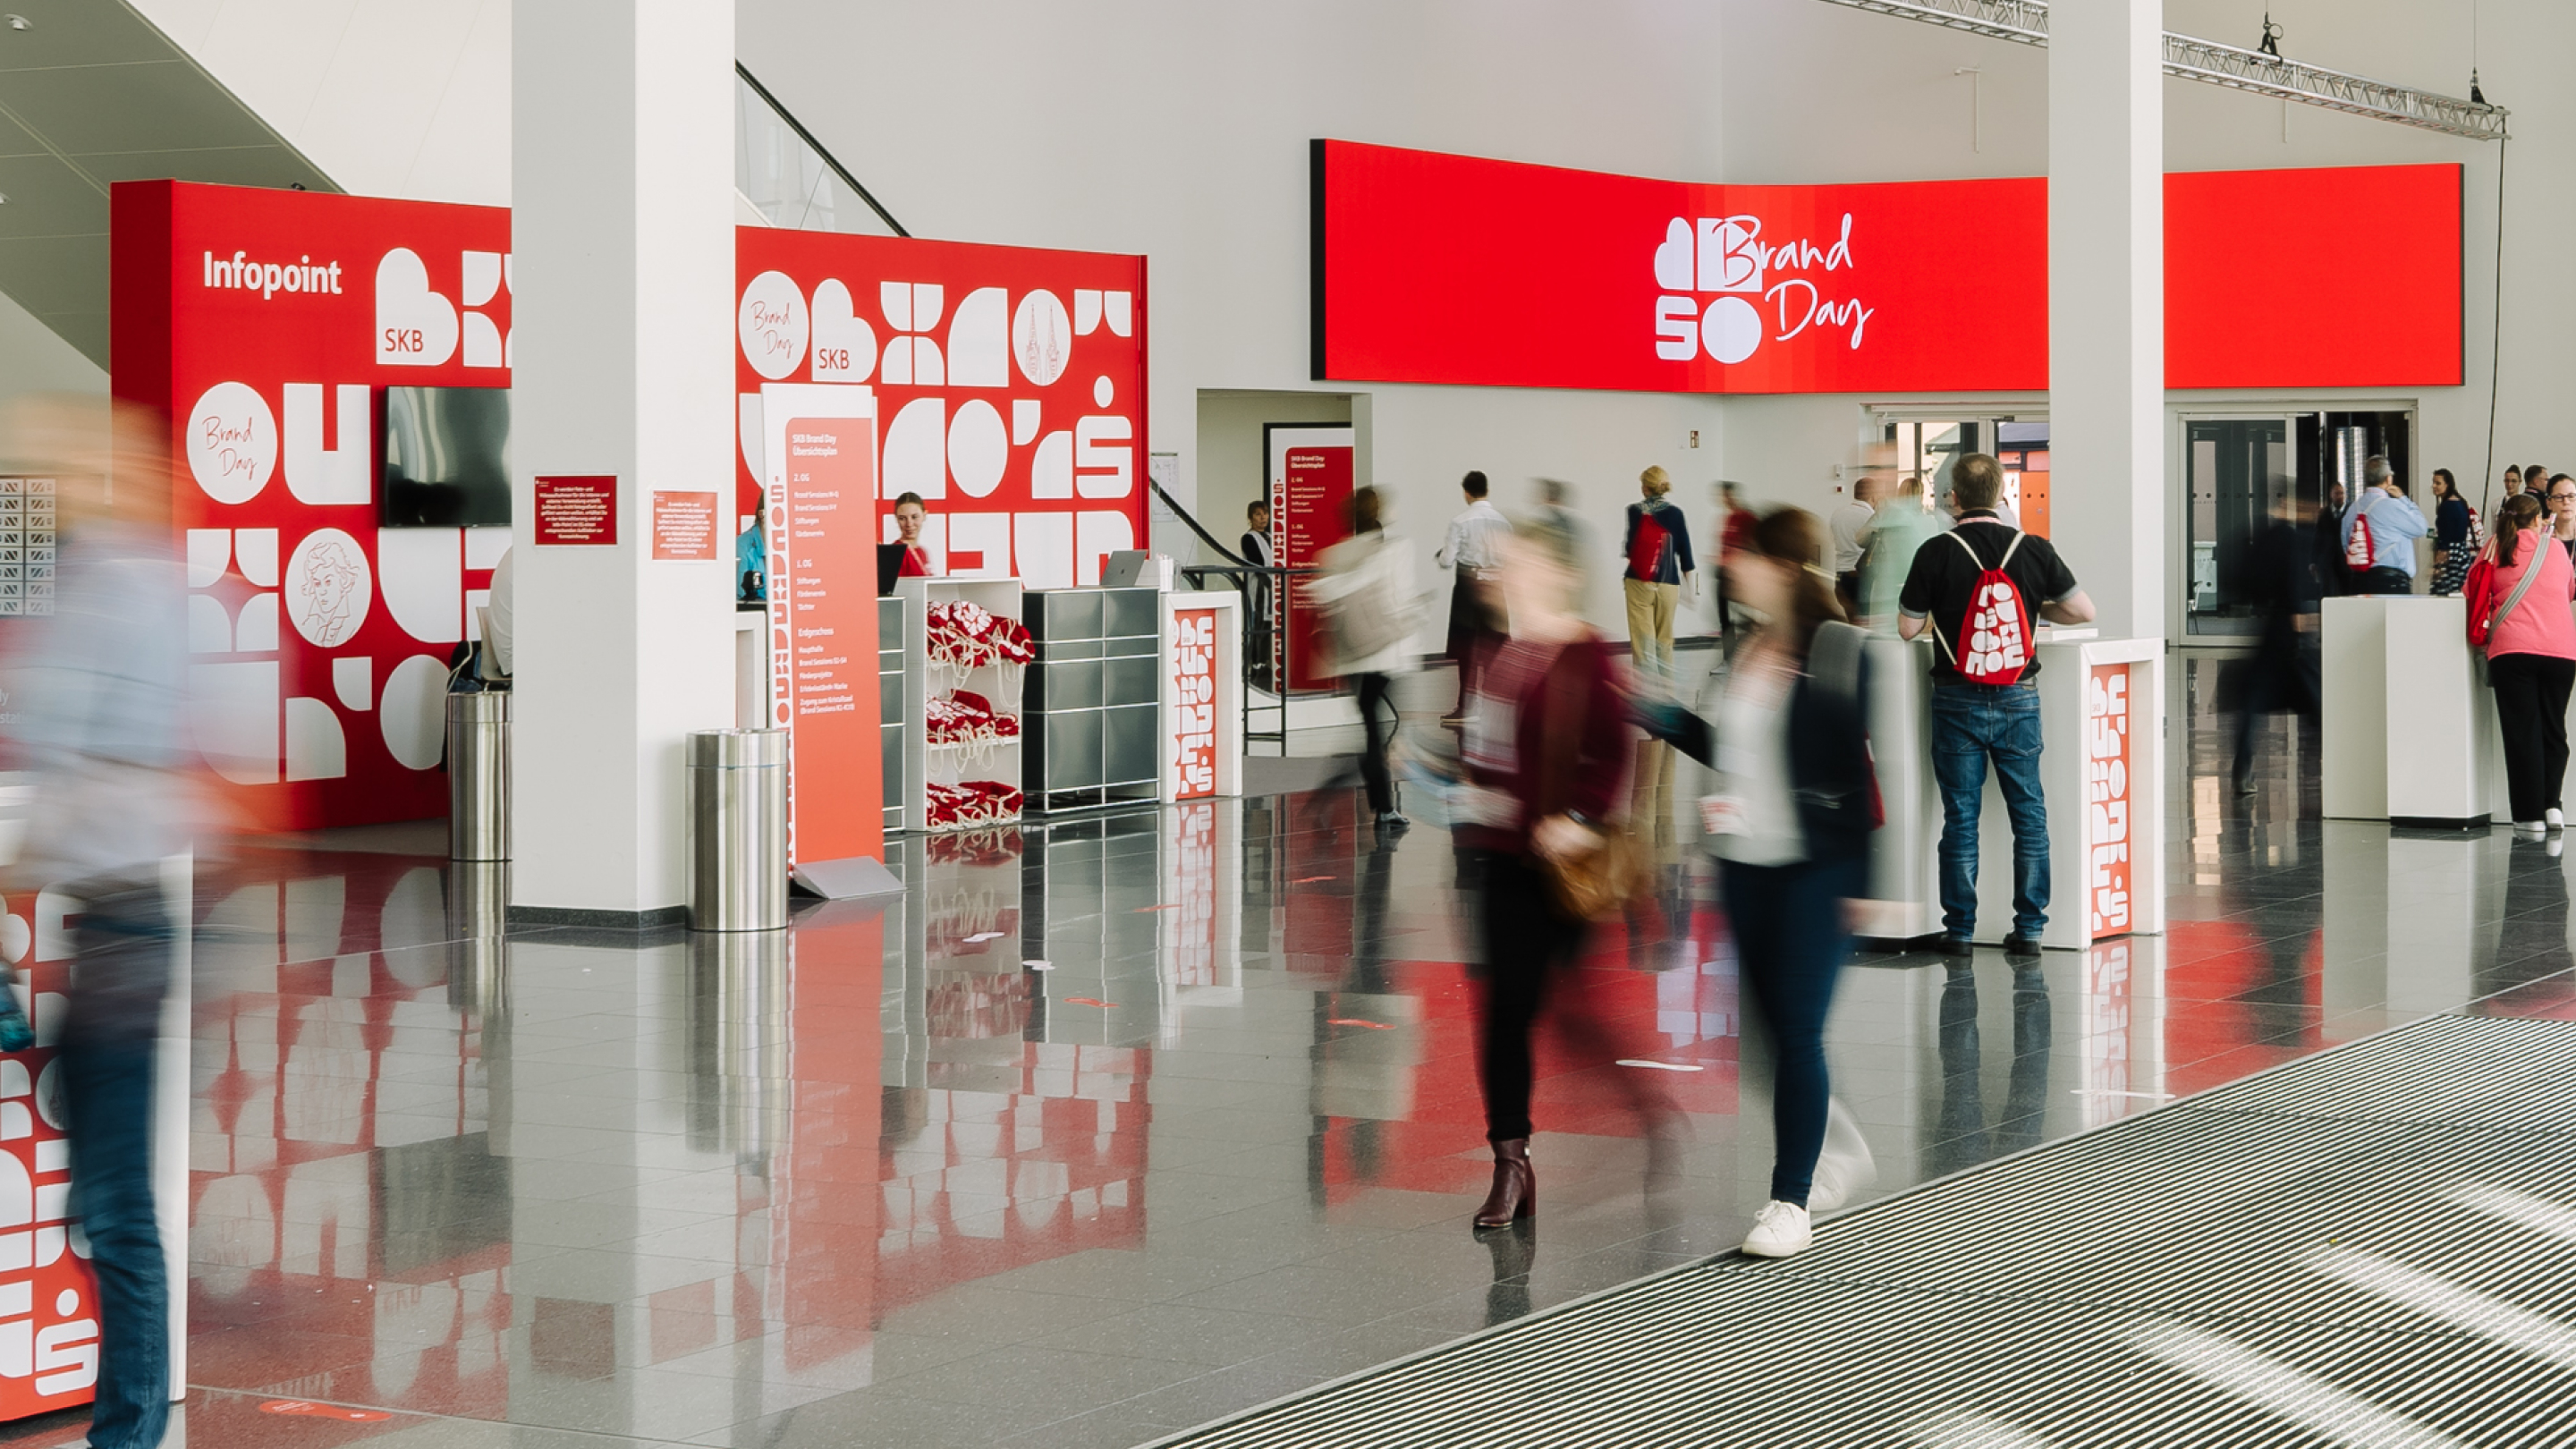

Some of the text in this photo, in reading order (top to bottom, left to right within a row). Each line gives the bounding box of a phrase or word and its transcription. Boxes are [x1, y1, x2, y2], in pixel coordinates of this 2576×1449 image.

[1712, 212, 1853, 287] Brand
[204, 250, 343, 300] Infopoint
[750, 300, 792, 331] Brand
[1764, 279, 1875, 350] Day
[384, 327, 424, 353] SKB
[764, 329, 794, 359] Day
[818, 348, 851, 370] SKB
[202, 415, 253, 456] Brand
[806, 434, 824, 443] Brand
[825, 434, 836, 445] Day
[218, 447, 258, 487] Day
